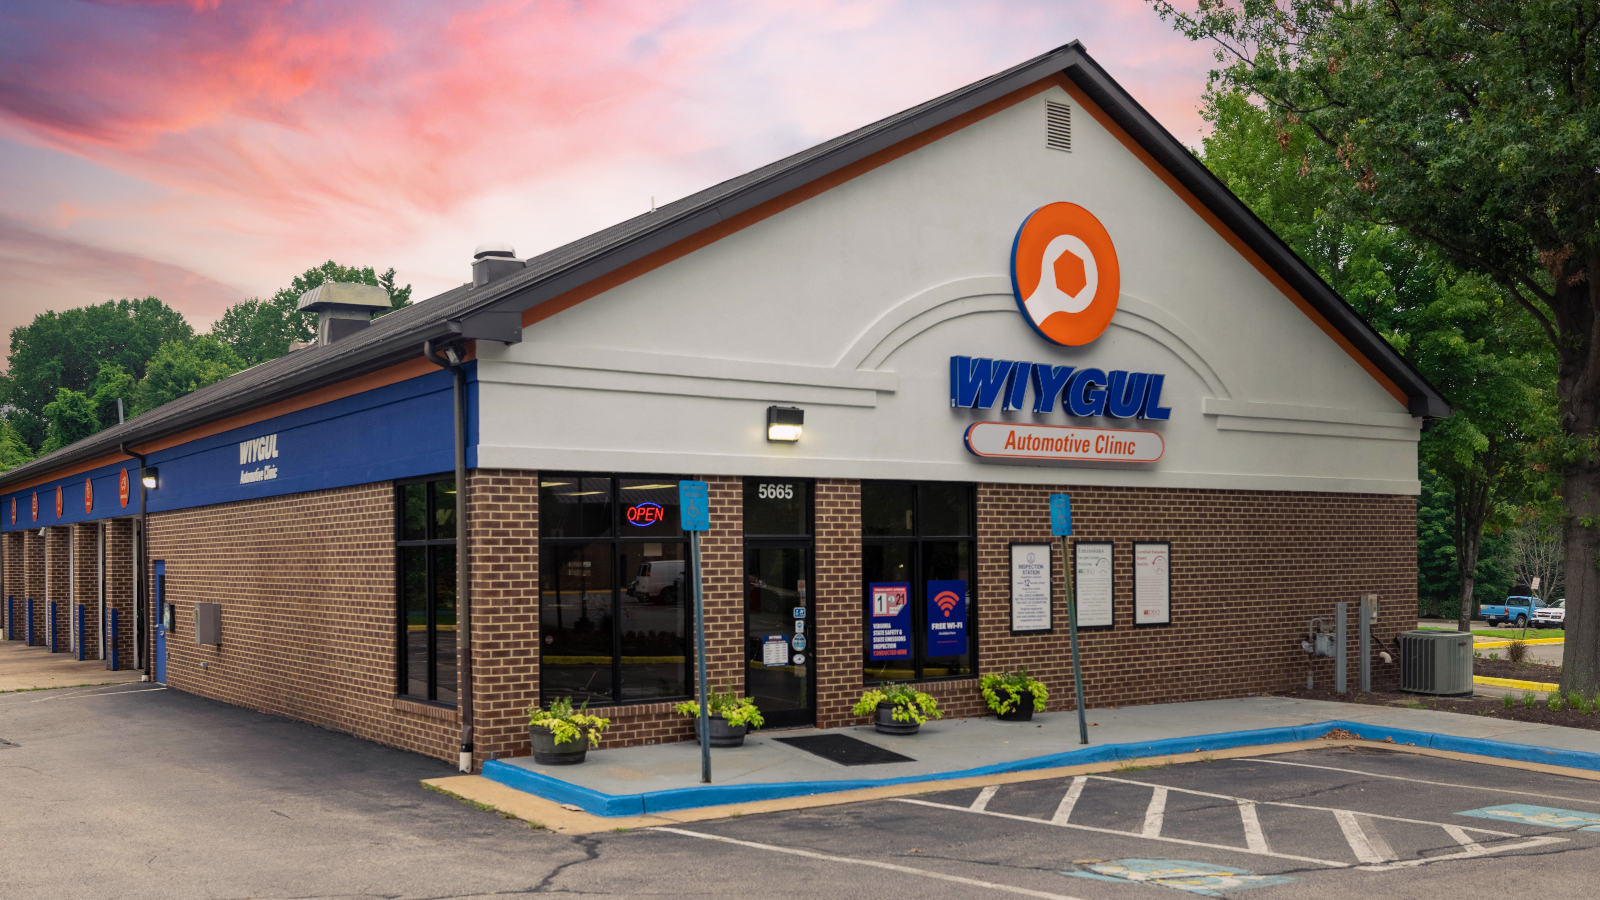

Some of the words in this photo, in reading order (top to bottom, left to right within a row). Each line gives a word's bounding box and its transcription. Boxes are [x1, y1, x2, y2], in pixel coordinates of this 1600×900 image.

[950, 355, 1172, 420] WIYGUL
[239, 434, 279, 465] WIYGUL
[1004, 430, 1090, 453] Automotive
[1095, 435, 1136, 455] Clinic
[239, 467, 264, 485] Automotive
[263, 464, 278, 481] Clinic
[758, 483, 794, 500] 5665
[626, 506, 665, 522] OPEN
[1024, 579, 1031, 587] 12
[877, 595, 883, 612] 1
[896, 594, 905, 606] 21
[931, 622, 947, 631] FREE
[946, 621, 963, 630] WI-FI
